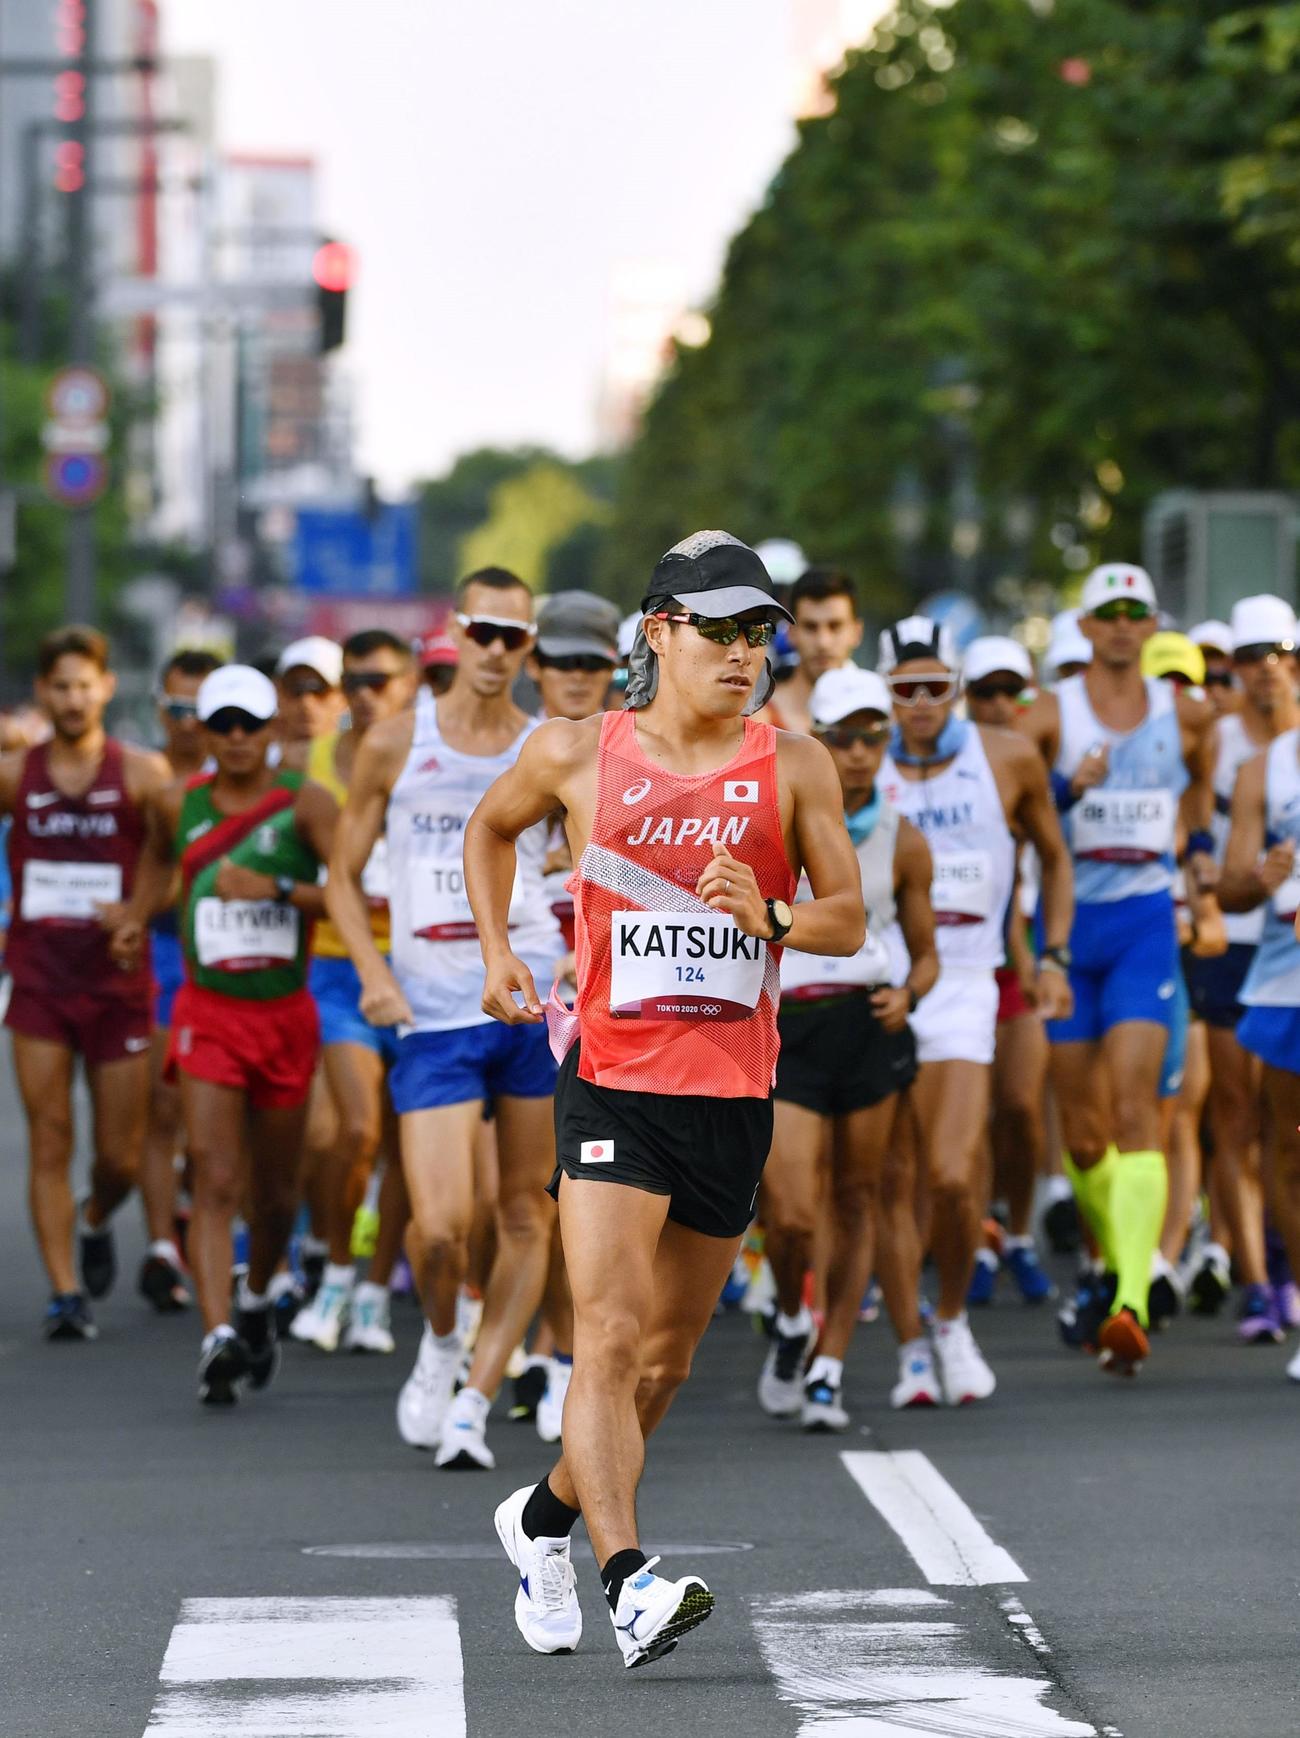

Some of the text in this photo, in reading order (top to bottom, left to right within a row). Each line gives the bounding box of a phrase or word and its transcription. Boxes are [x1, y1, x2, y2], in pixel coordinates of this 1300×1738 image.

[1111, 800, 1164, 822] LUCA
[27, 813, 118, 837] LATVIA
[412, 813, 465, 834] SLOV
[627, 816, 750, 846] JAPAN
[433, 870, 464, 894] TO
[620, 924, 760, 960] KATSUKI
[675, 966, 705, 983] 124
[656, 1004, 698, 1013] TOKYO 2020
